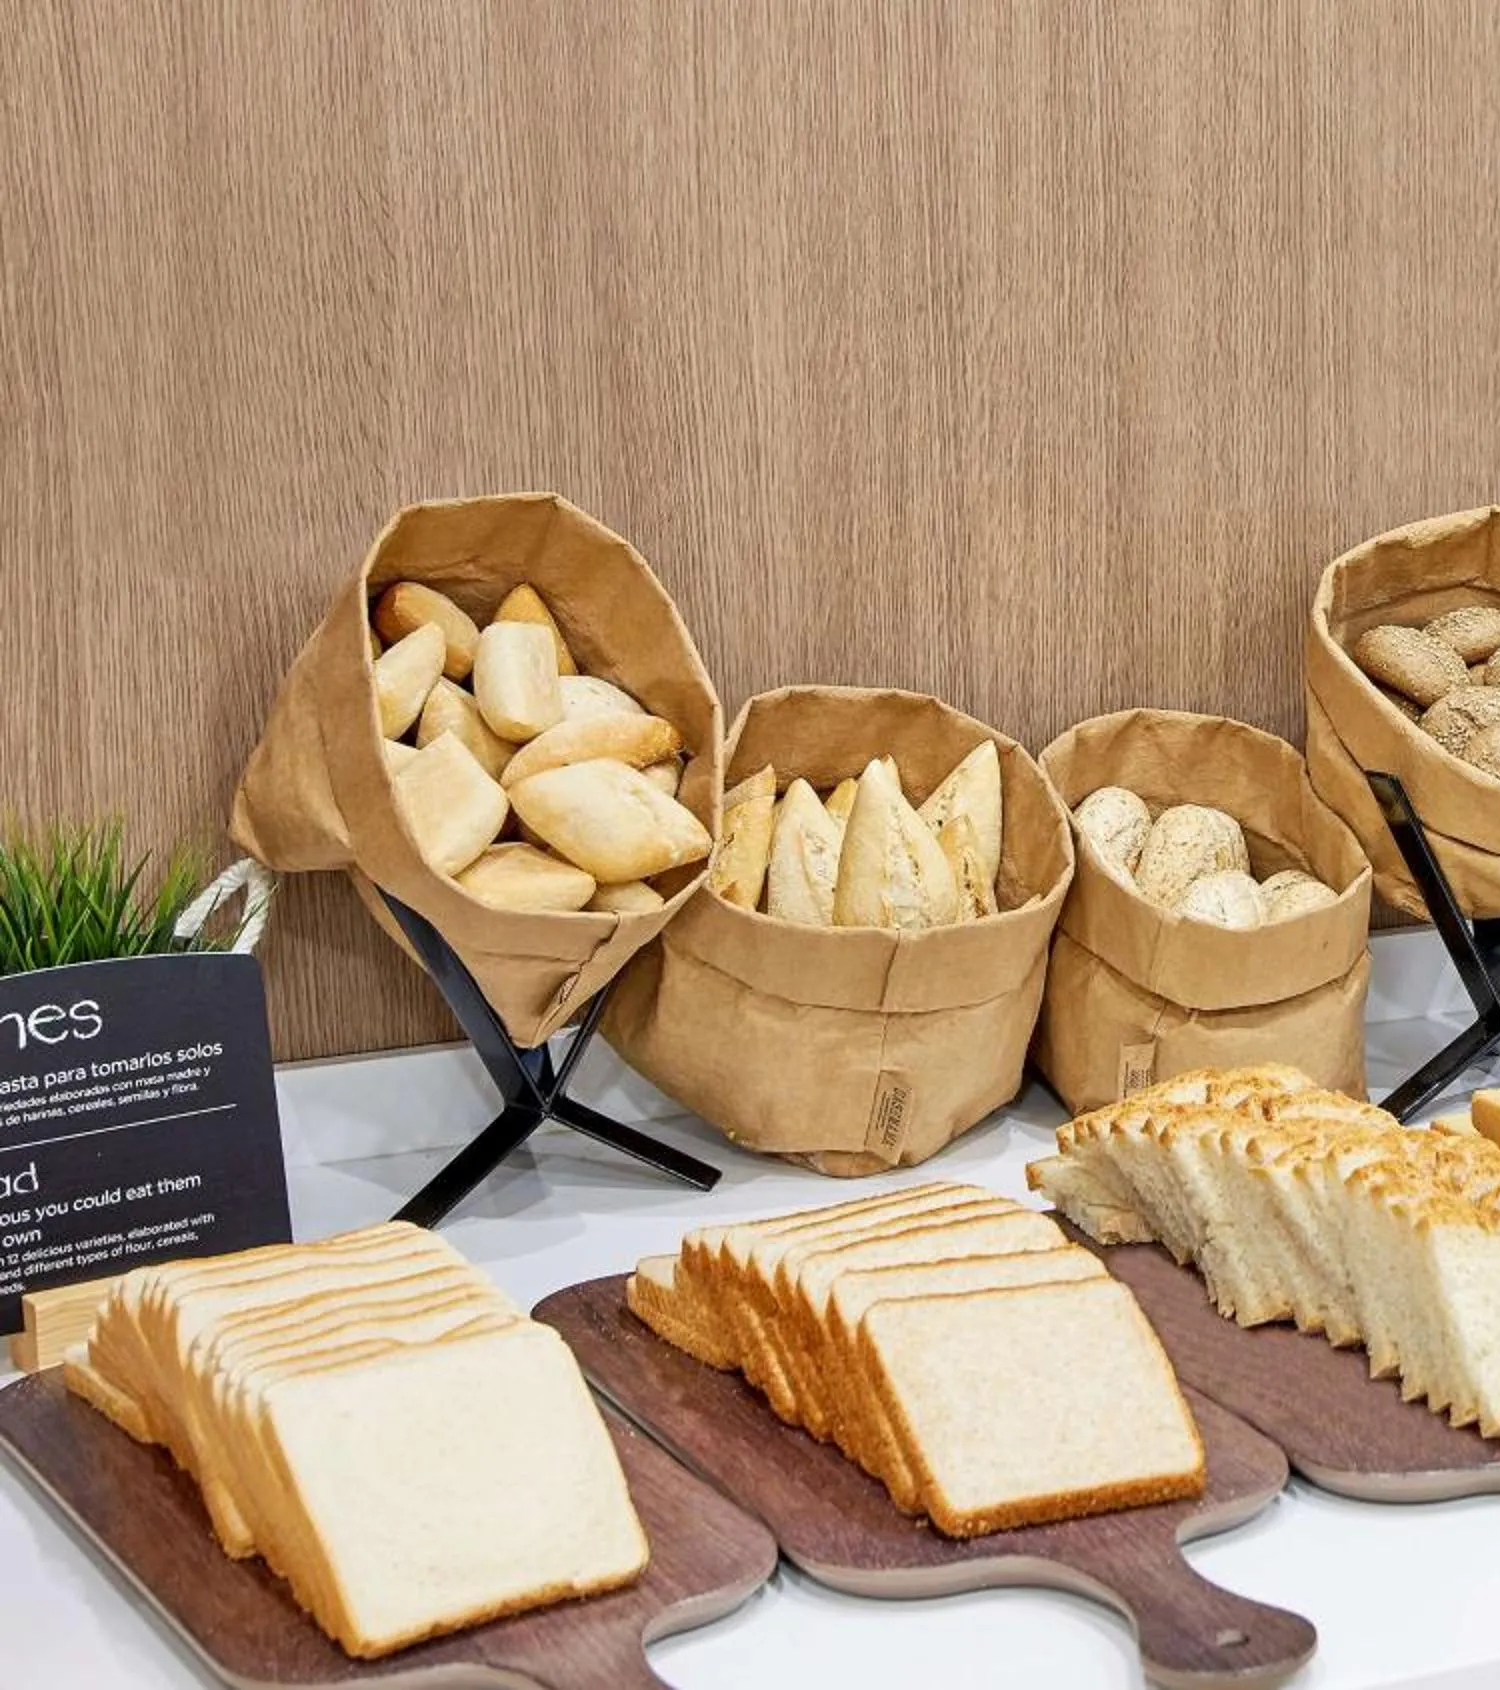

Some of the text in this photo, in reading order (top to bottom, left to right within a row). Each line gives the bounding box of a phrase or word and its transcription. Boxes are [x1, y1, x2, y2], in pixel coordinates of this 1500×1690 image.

[43, 1066, 87, 1089] para
[91, 1051, 173, 1078] tomarlos
[177, 1042, 223, 1063] solos
[111, 1080, 133, 1093] con
[135, 1074, 165, 1088] masa
[166, 1067, 203, 1082] madre
[203, 1065, 211, 1077] y
[5, 1114, 21, 1127] de
[161, 1087, 171, 1099] y
[0, 1174, 201, 1227] ous you could eat them
[2, 1228, 42, 1248] own
[7, 1253, 20, 1265] 12
[21, 1243, 73, 1262] delicious
[127, 1217, 190, 1240] elaborated
[190, 1212, 216, 1227] with
[23, 1256, 75, 1277] different
[76, 1249, 109, 1267] types
[110, 1244, 123, 1257] of
